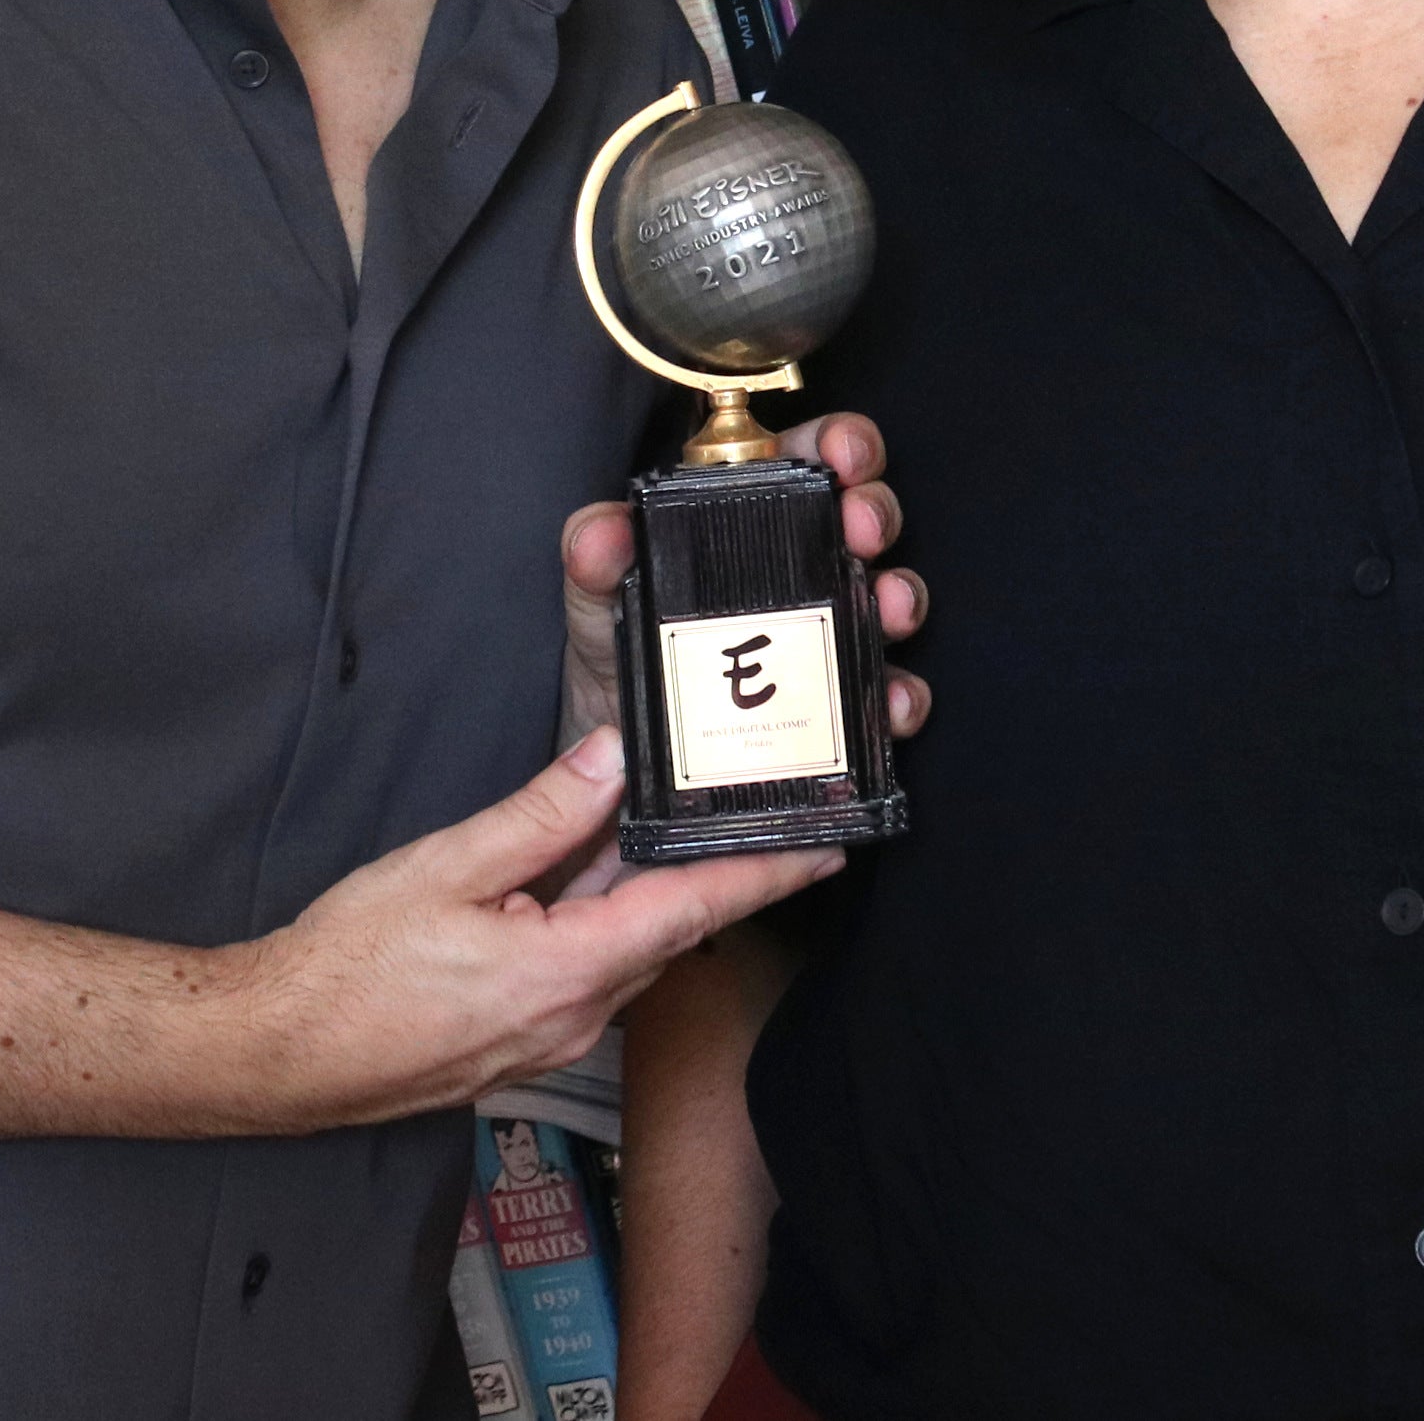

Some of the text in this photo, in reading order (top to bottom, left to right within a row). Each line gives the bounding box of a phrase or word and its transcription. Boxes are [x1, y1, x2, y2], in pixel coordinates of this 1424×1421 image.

[735, 5, 755, 51] LEIVA
[649, 189, 832, 272] COMIC INDUSTRY AWARDS
[696, 230, 807, 291] 2021
[721, 634, 777, 709] E
[702, 718, 813, 739] BEST DIGITAL COMIC
[491, 1186, 575, 1224] TERRY
[542, 1219, 567, 1232] THE
[501, 1231, 591, 1267] PIRATES
[533, 1288, 581, 1312] 1939
[544, 1333, 593, 1356] 1940
